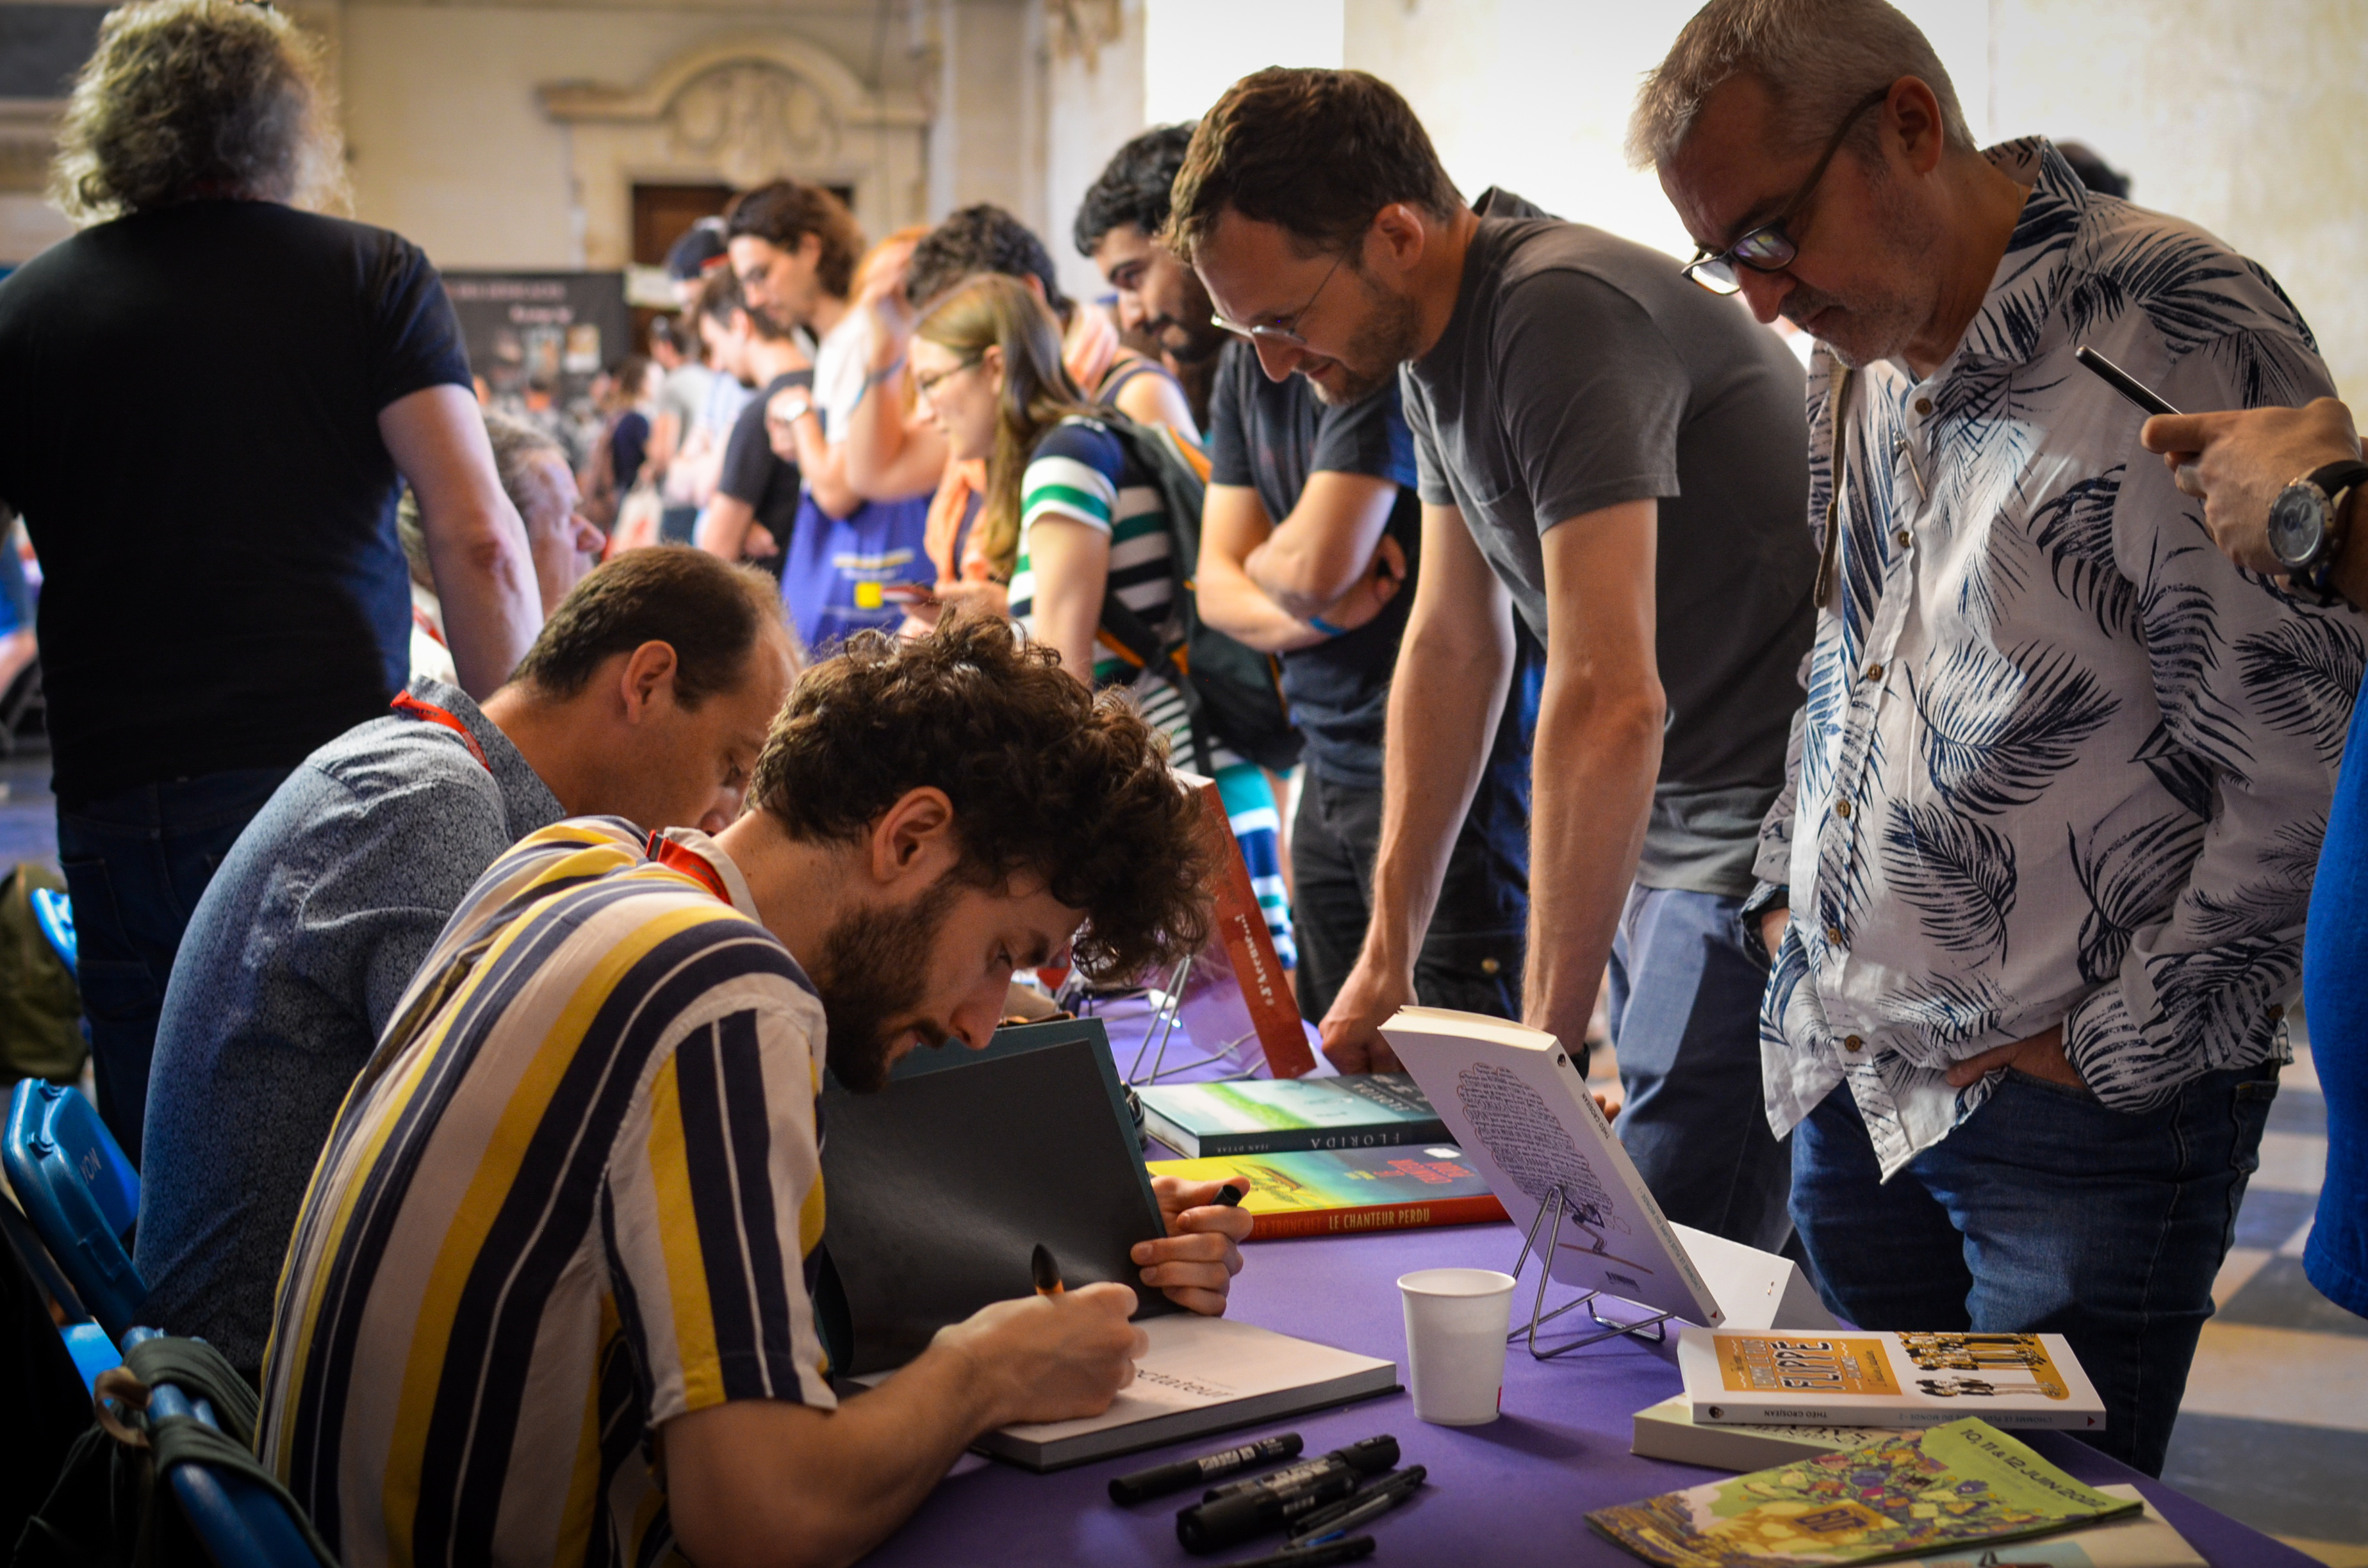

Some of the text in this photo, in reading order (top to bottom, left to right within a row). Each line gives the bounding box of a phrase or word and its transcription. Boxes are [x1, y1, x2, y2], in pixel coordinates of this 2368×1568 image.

[1311, 1133, 1399, 1149] FLORIDA
[79, 1147, 102, 1185] YON
[1329, 1207, 1431, 1230] LE CHANTEUR PERDU
[1137, 1369, 1235, 1398] ctateur
[1764, 1409, 1804, 1417] GROSJEAN
[1961, 1429, 1982, 1444] 10,
[1980, 1442, 1998, 1452] 11
[1991, 1450, 2005, 1458] &
[2003, 1456, 2026, 1469] 12
[2019, 1469, 2062, 1490] JUIN
